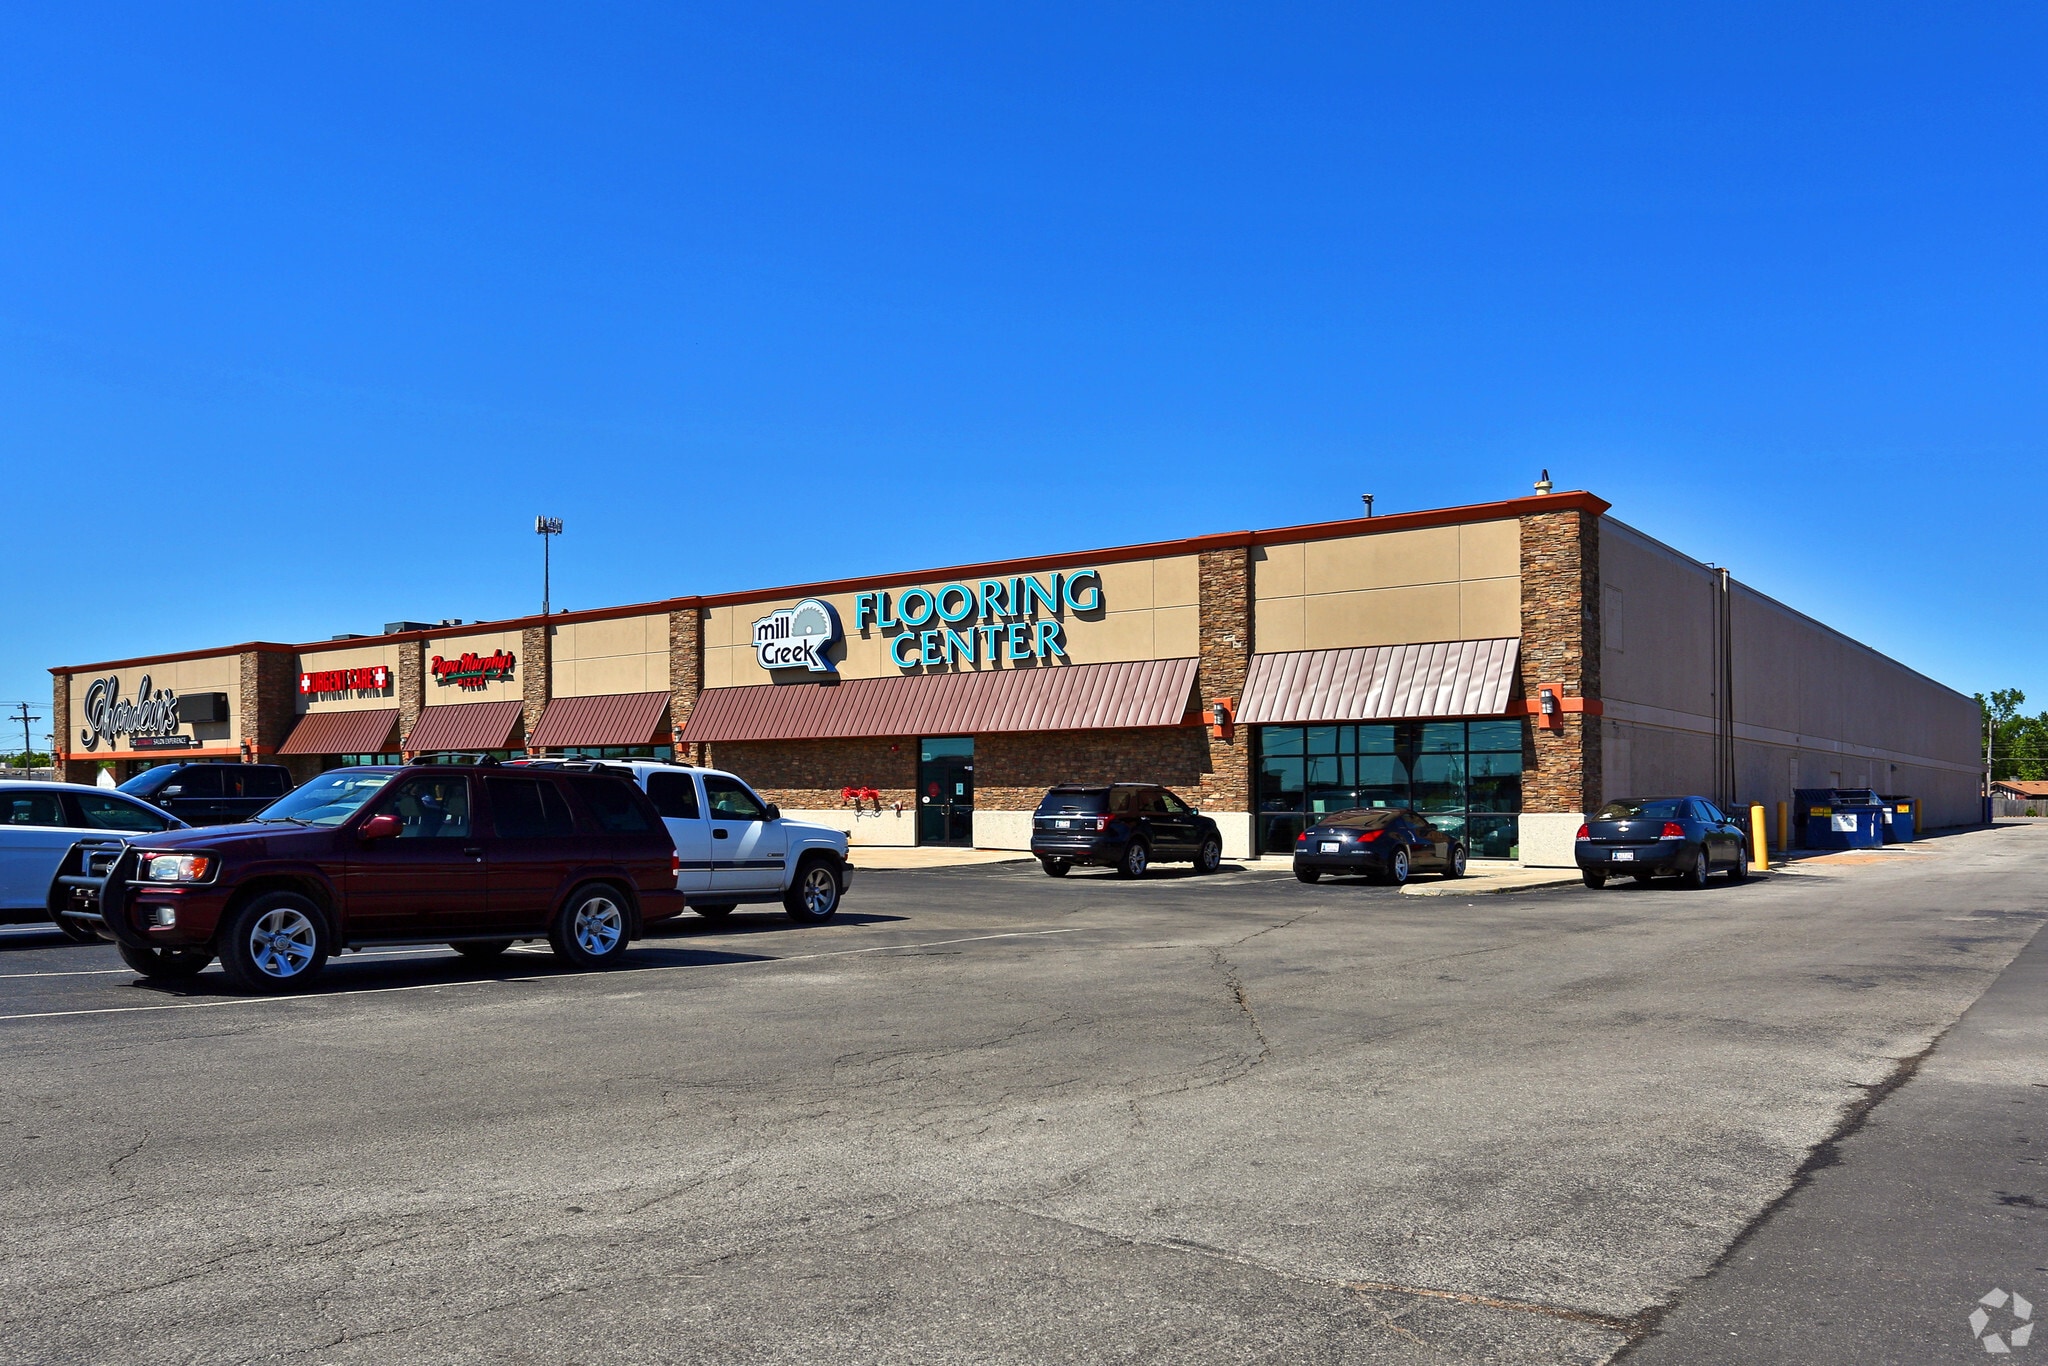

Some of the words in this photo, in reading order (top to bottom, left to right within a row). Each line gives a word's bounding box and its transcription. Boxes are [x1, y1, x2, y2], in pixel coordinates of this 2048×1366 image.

[855, 569, 1099, 630] FLOORING
[757, 616, 790, 641] mill
[762, 639, 819, 667] Creek
[890, 620, 1065, 668] CENTER
[311, 669, 349, 693] URGENT
[349, 666, 374, 690] CARE
[431, 655, 460, 683] Papa
[460, 648, 515, 679] Murphy's
[457, 678, 484, 687] PIZZA
